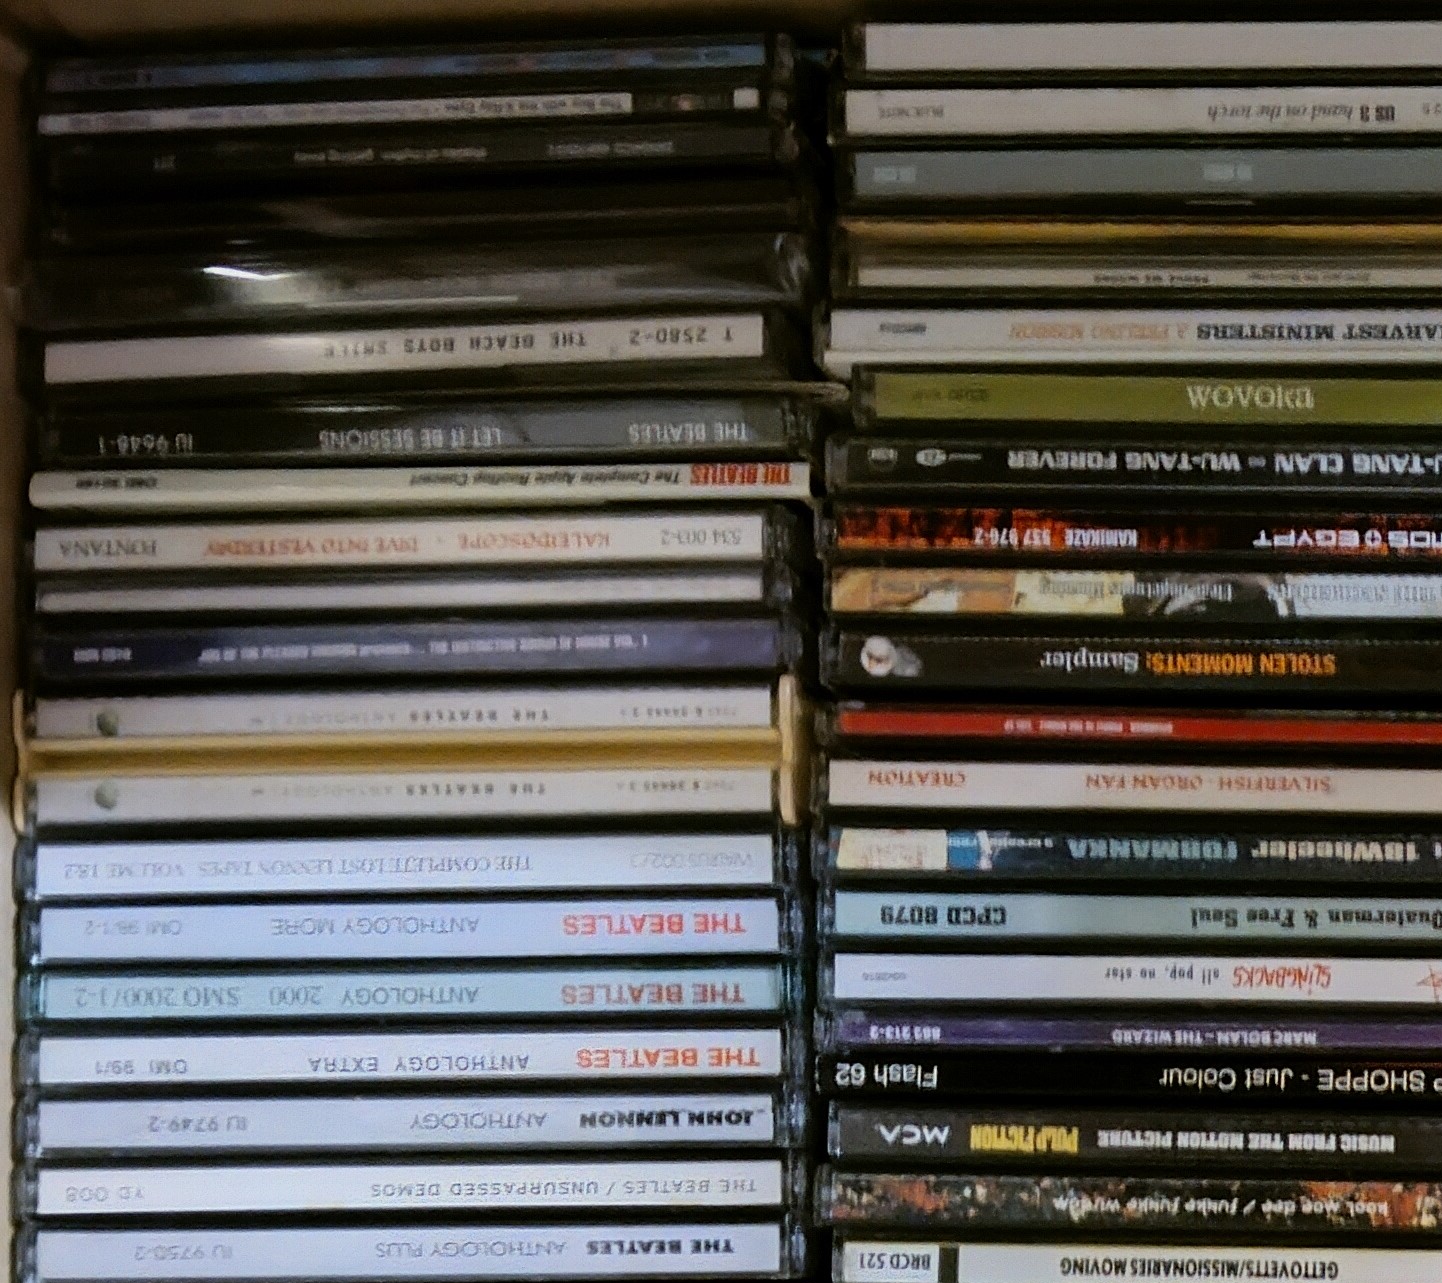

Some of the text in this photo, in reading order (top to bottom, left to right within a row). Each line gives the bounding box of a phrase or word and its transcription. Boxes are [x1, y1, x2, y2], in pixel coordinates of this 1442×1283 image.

[1196, 322, 1335, 342] MINISTERS
[1007, 450, 1117, 471] FOREVER
[1125, 450, 1241, 472] WU-TANG
[1274, 452, 1344, 473] CLAN
[1040, 648, 1337, 675] STOLEN MOMENTS: Sampler
[271, 913, 746, 936] THE BEATLES ANTHOLOGY MORE
[835, 1062, 939, 1087] Flash 62
[1158, 1066, 1237, 1089] Colour
[1243, 1067, 1294, 1091] Just
[1318, 1068, 1426, 1092] SHOPPE
[859, 1252, 932, 1271] BRCD 521
[1060, 1257, 1128, 1278] MOVING
